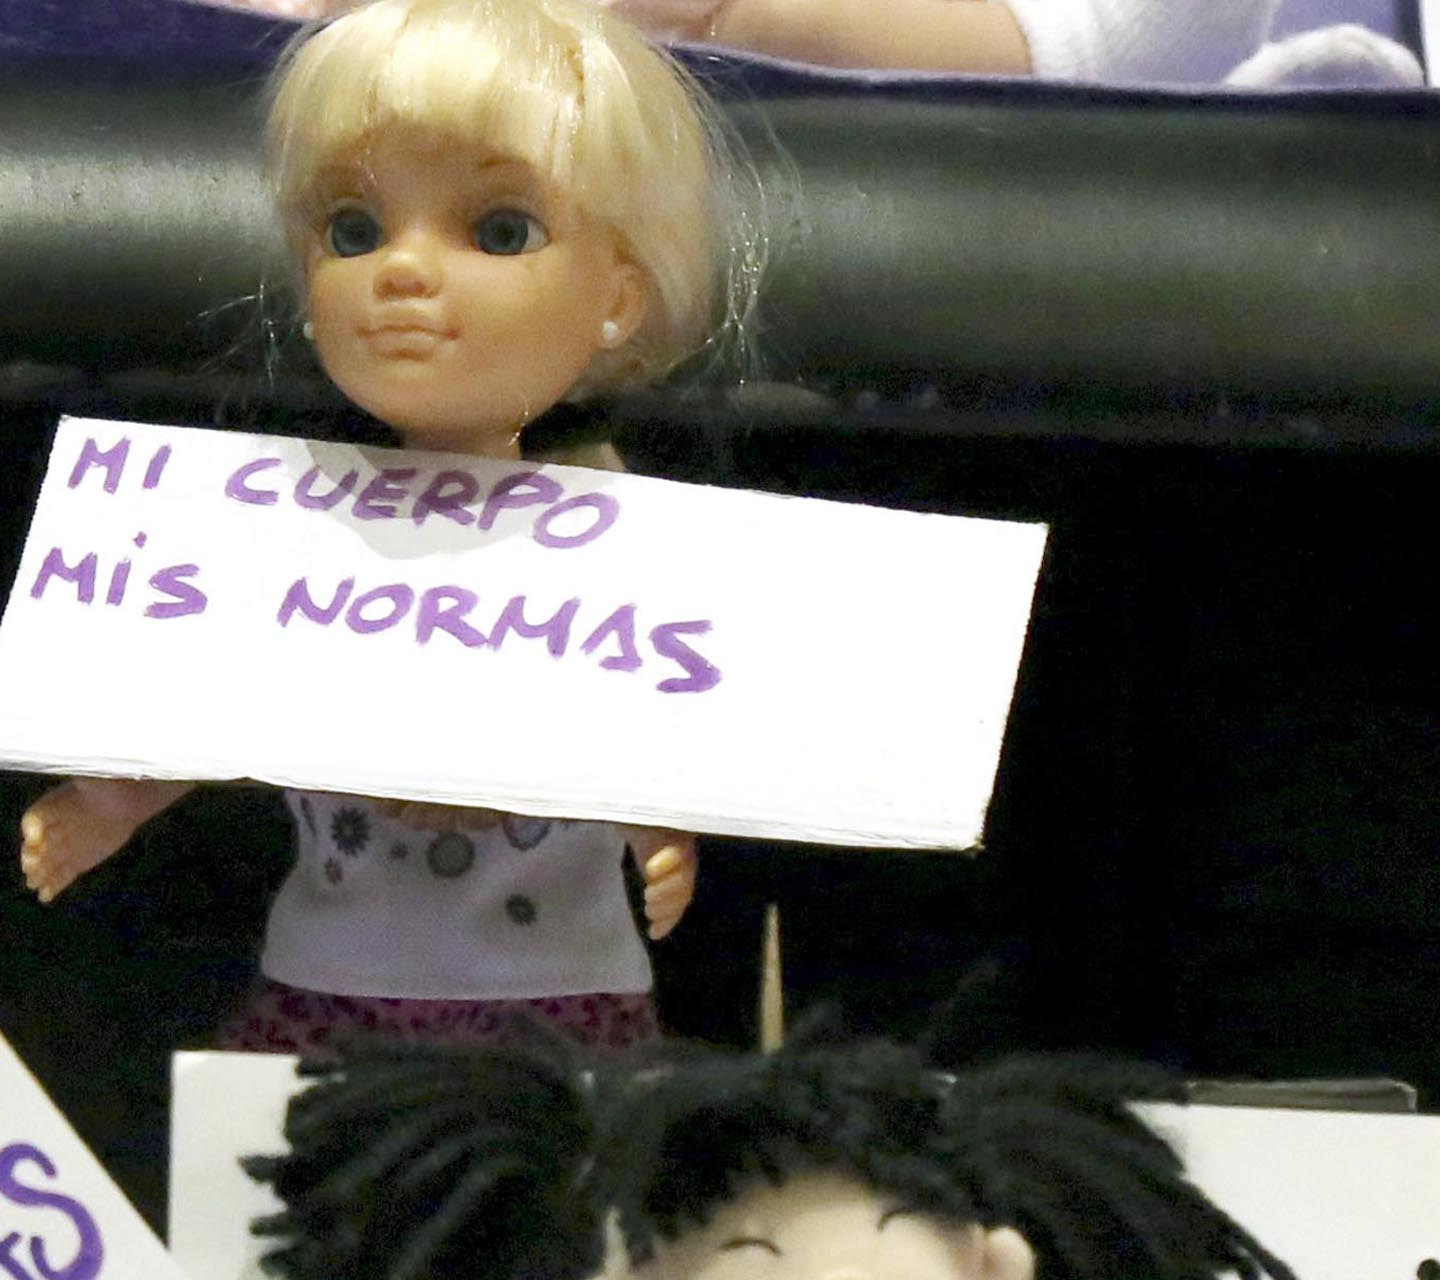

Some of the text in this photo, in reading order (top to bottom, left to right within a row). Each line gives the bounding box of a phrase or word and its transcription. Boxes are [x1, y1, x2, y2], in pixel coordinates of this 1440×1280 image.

[65, 436, 621, 550] MI CUERPO
[276, 574, 723, 695] NORMAS
